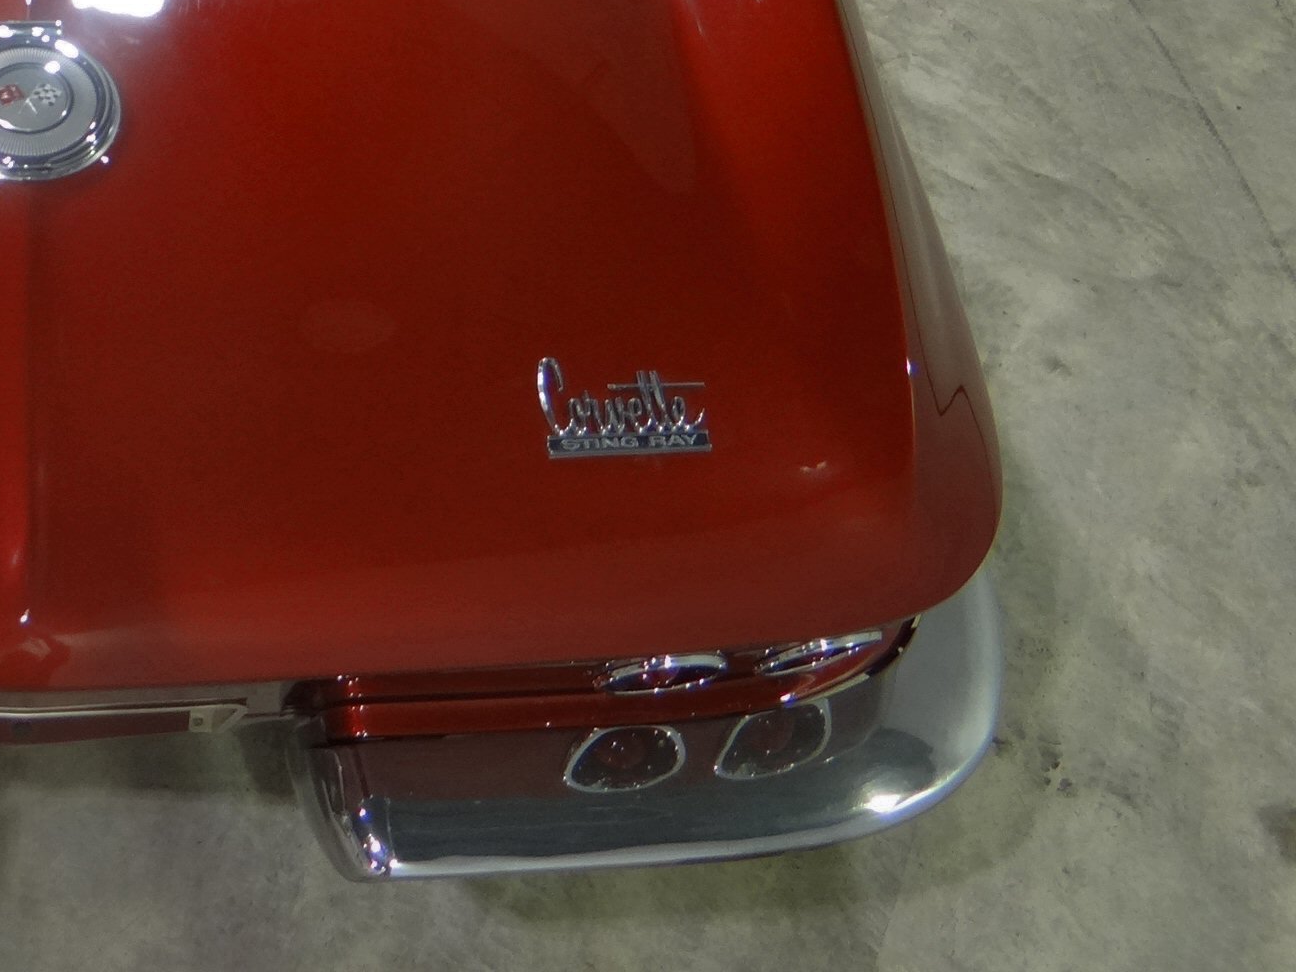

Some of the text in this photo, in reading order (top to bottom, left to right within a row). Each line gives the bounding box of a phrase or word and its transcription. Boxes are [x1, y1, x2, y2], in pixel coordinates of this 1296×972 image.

[537, 357, 705, 437] Corvette
[561, 433, 698, 450] STING RAY
